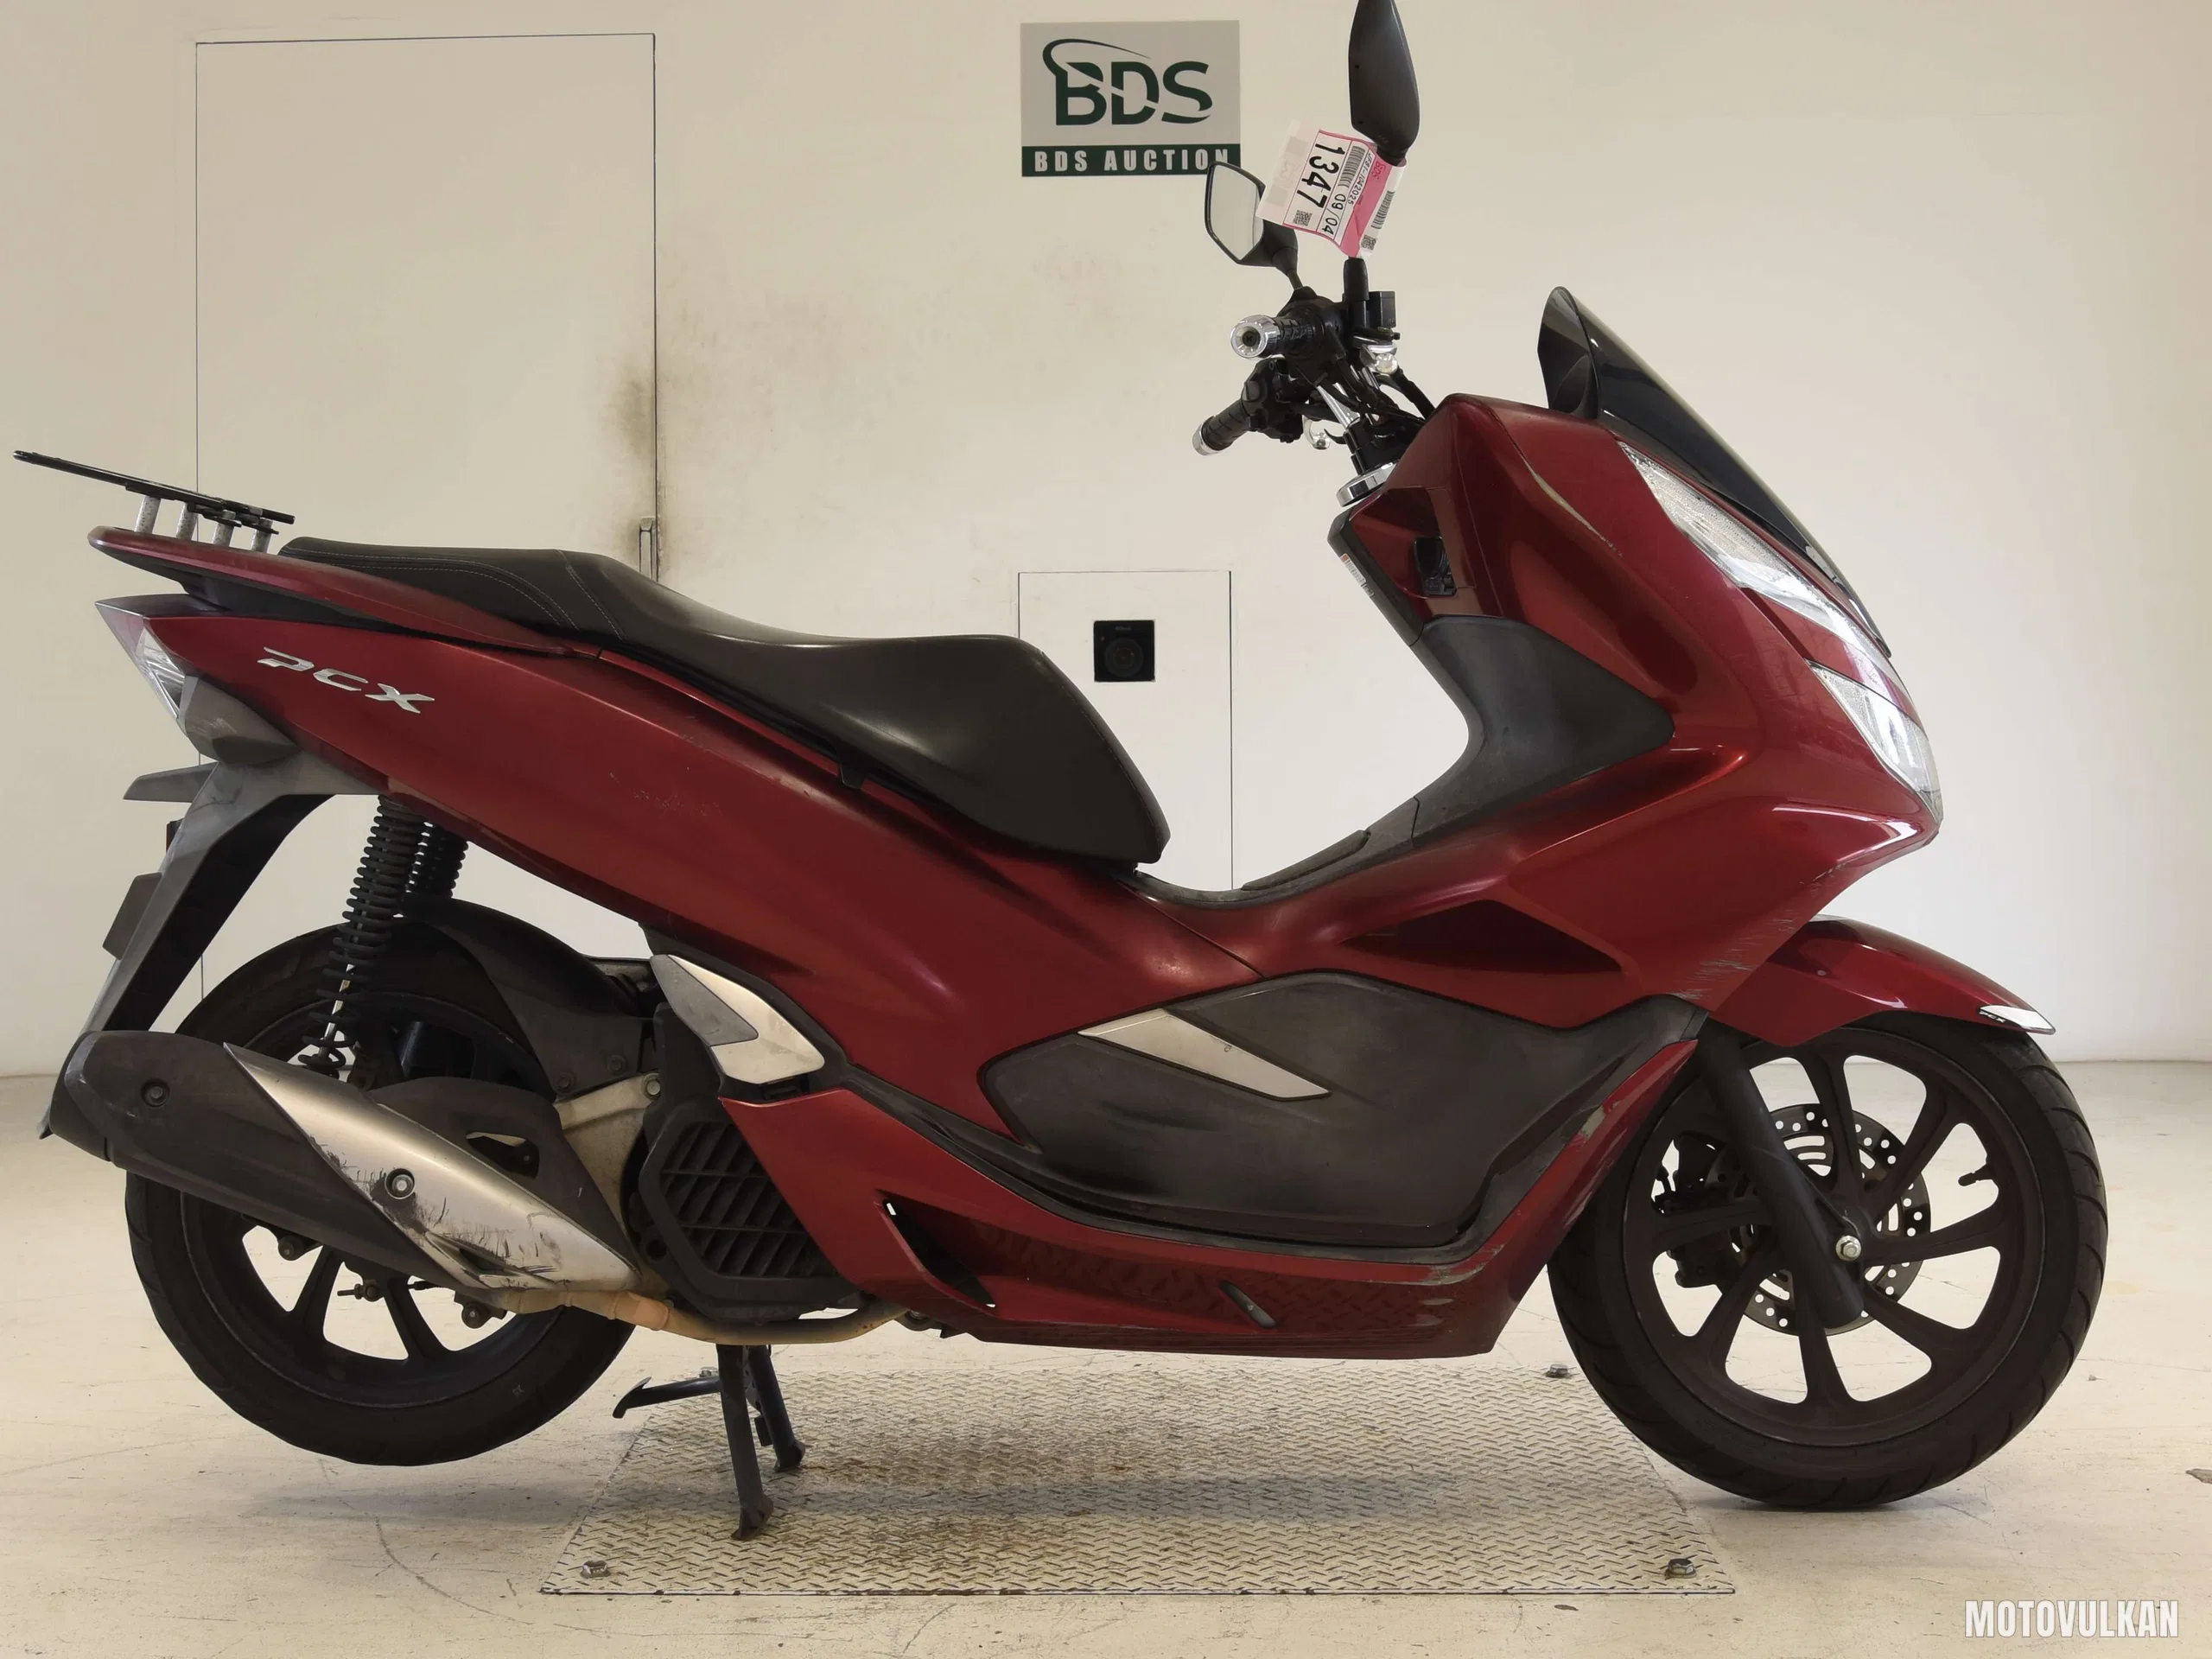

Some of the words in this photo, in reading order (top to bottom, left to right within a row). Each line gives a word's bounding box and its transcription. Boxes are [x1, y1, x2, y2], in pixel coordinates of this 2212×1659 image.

[1043, 38, 1213, 126] BDS
[1034, 150, 1088, 173] BDS
[1103, 149, 1229, 171] AUCTION
[1297, 143, 1345, 209] 1347
[1321, 194, 1346, 236] 09/04
[257, 646, 435, 714] PCX
